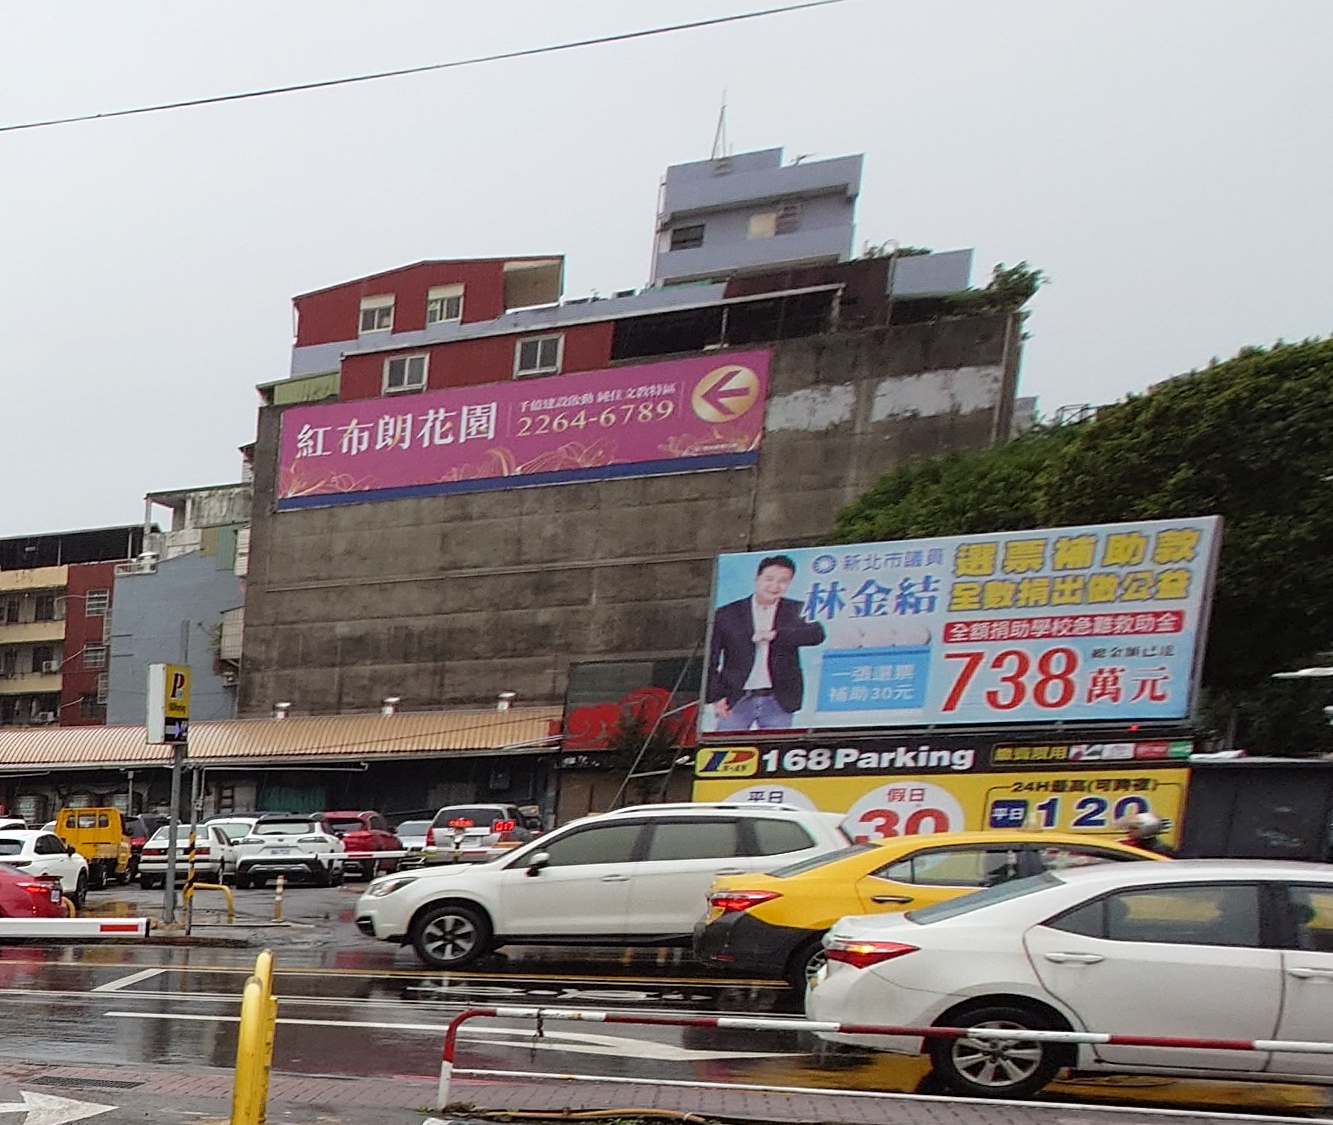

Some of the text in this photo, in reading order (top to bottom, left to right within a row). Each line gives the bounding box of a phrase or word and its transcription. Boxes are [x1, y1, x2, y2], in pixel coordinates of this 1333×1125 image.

[296, 402, 498, 458] 紅布朗花園
[517, 400, 673, 437] 2264-6789
[843, 548, 944, 571] 新北市議員
[953, 527, 1201, 577] 選票補助款
[801, 575, 941, 621] 林金結
[947, 568, 1191, 611] 全數捐出做公益
[949, 613, 1177, 641] 全額捐助學校急難救助金
[942, 648, 1078, 712] 738
[1086, 666, 1170, 704] 萬元
[762, 746, 975, 772] 168 Parking
[887, 787, 926, 802] 假日
[854, 809, 950, 844] 30
[993, 807, 1024, 820] 平日
